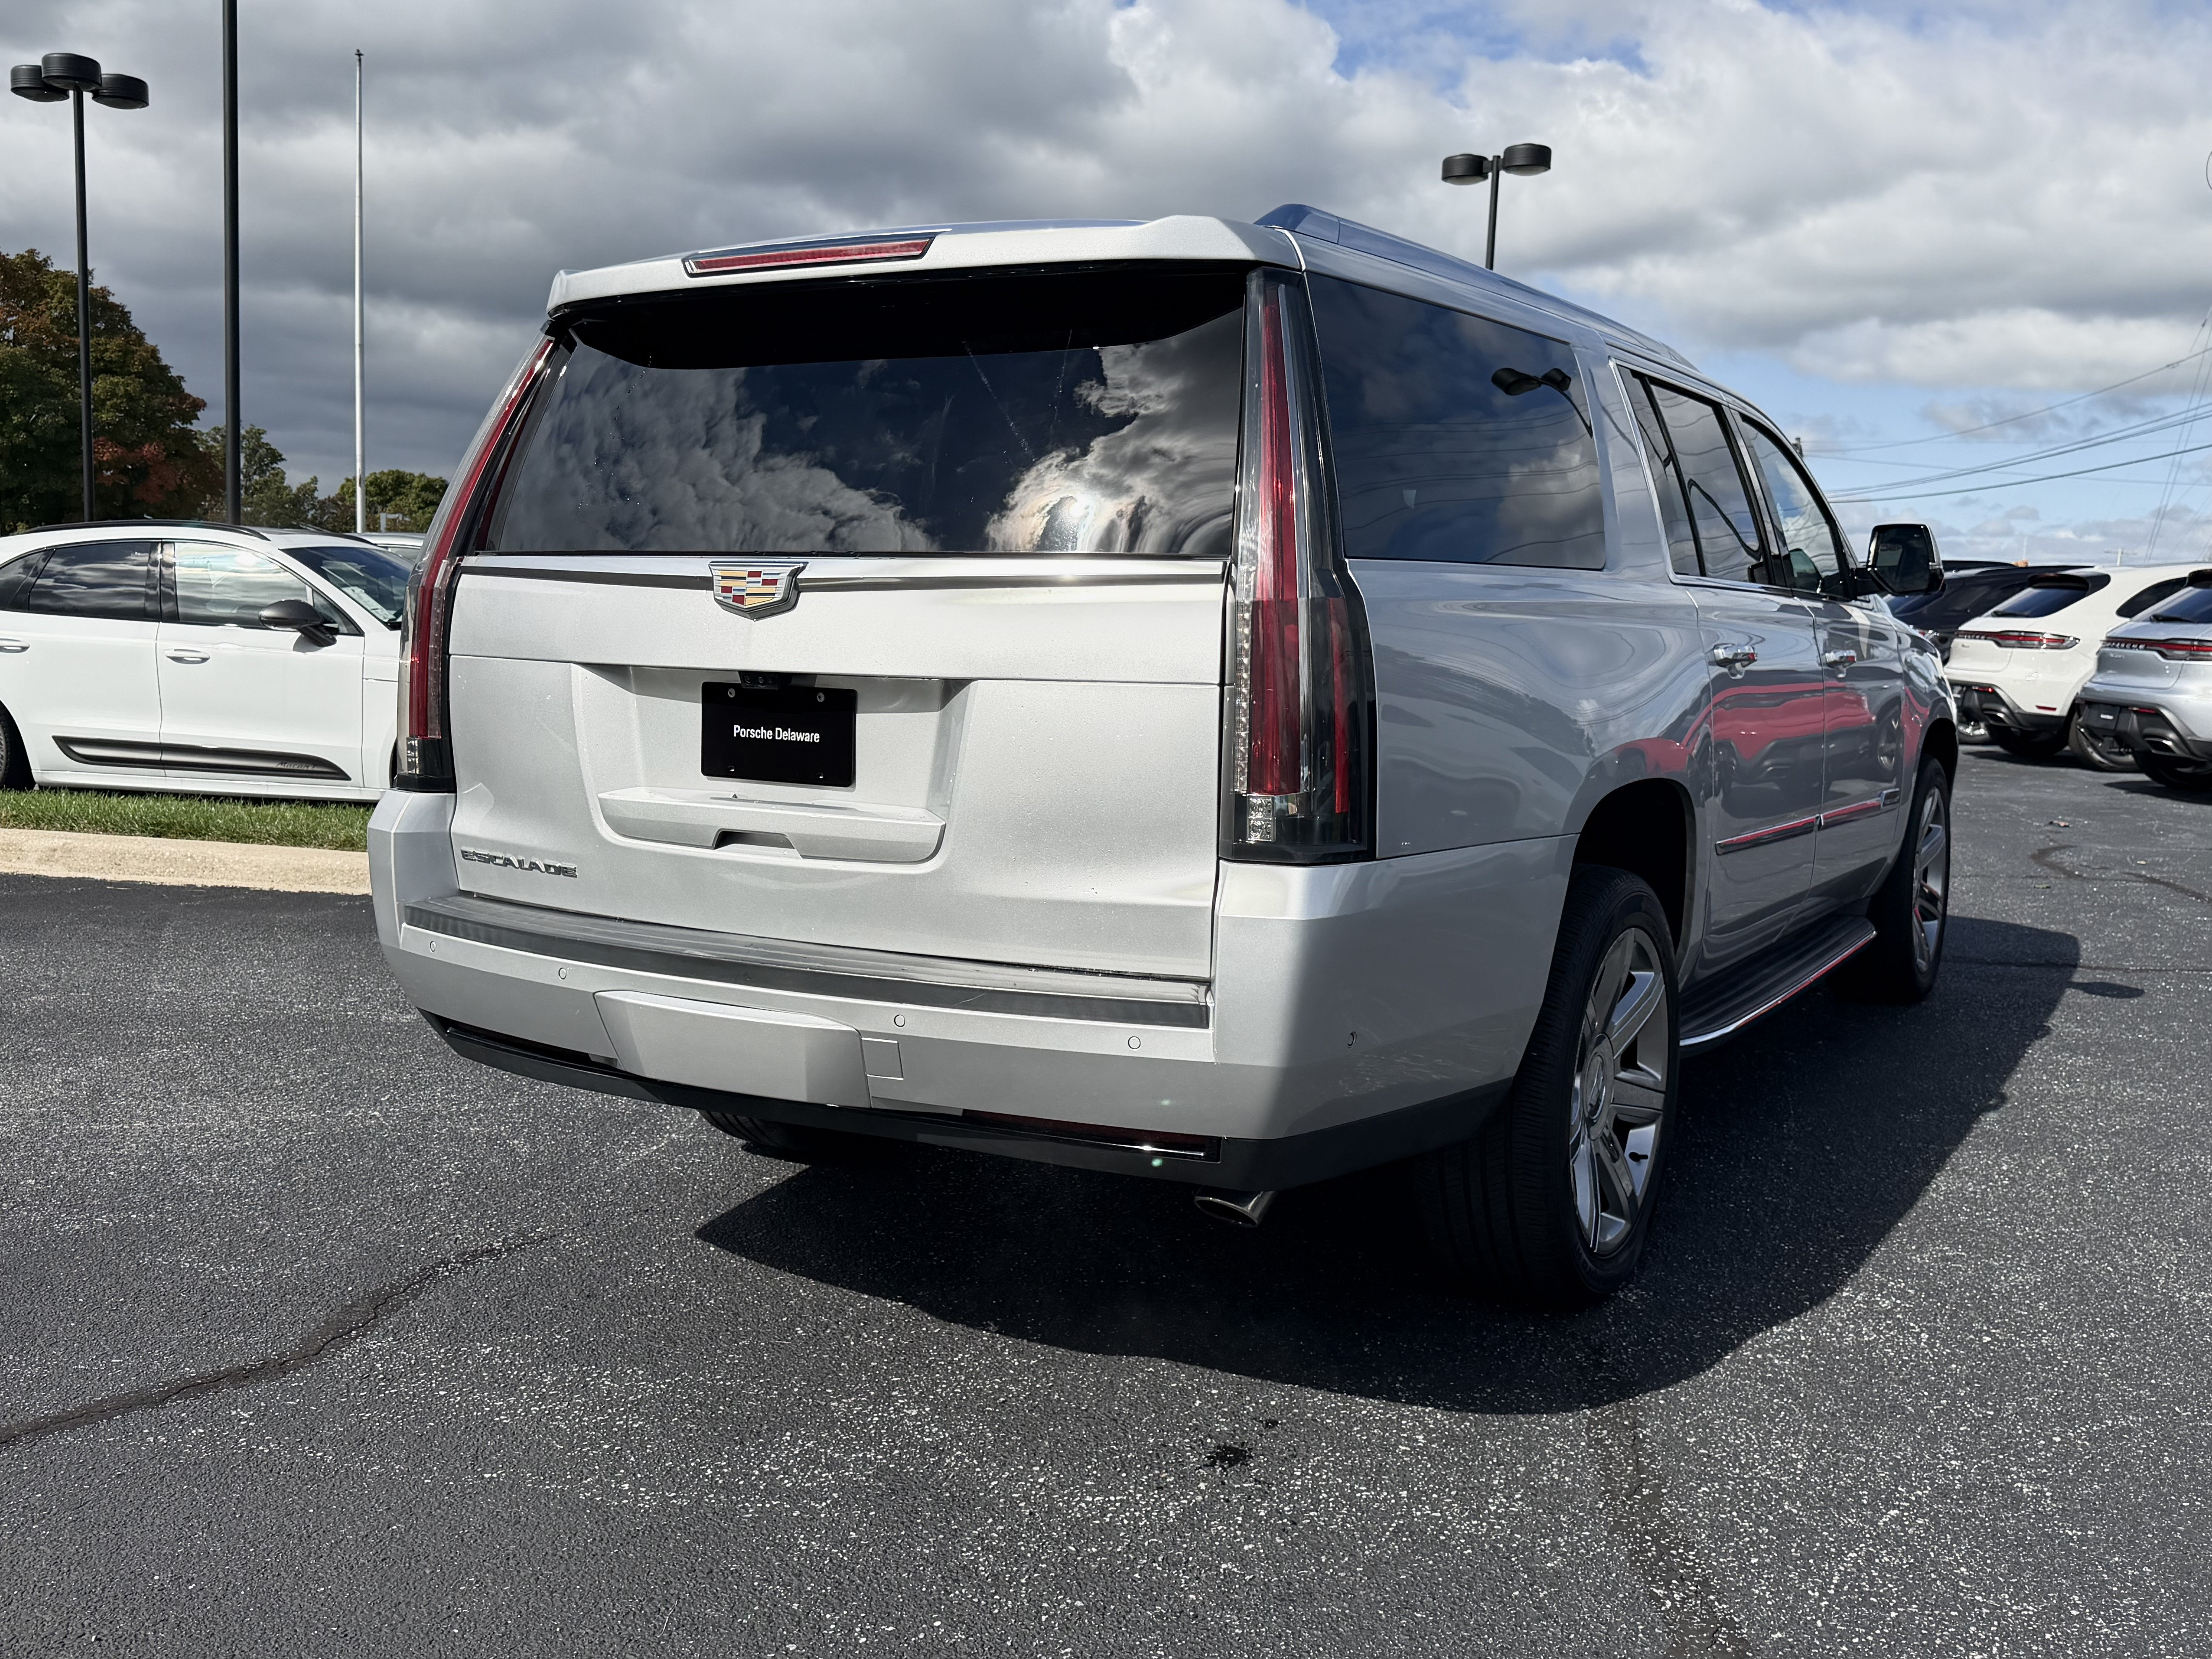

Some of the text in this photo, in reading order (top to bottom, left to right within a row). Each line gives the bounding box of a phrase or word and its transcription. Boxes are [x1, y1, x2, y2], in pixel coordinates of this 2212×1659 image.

[734, 725, 820, 742] Porsche Delaware
[460, 847, 577, 878] ESCALADE
